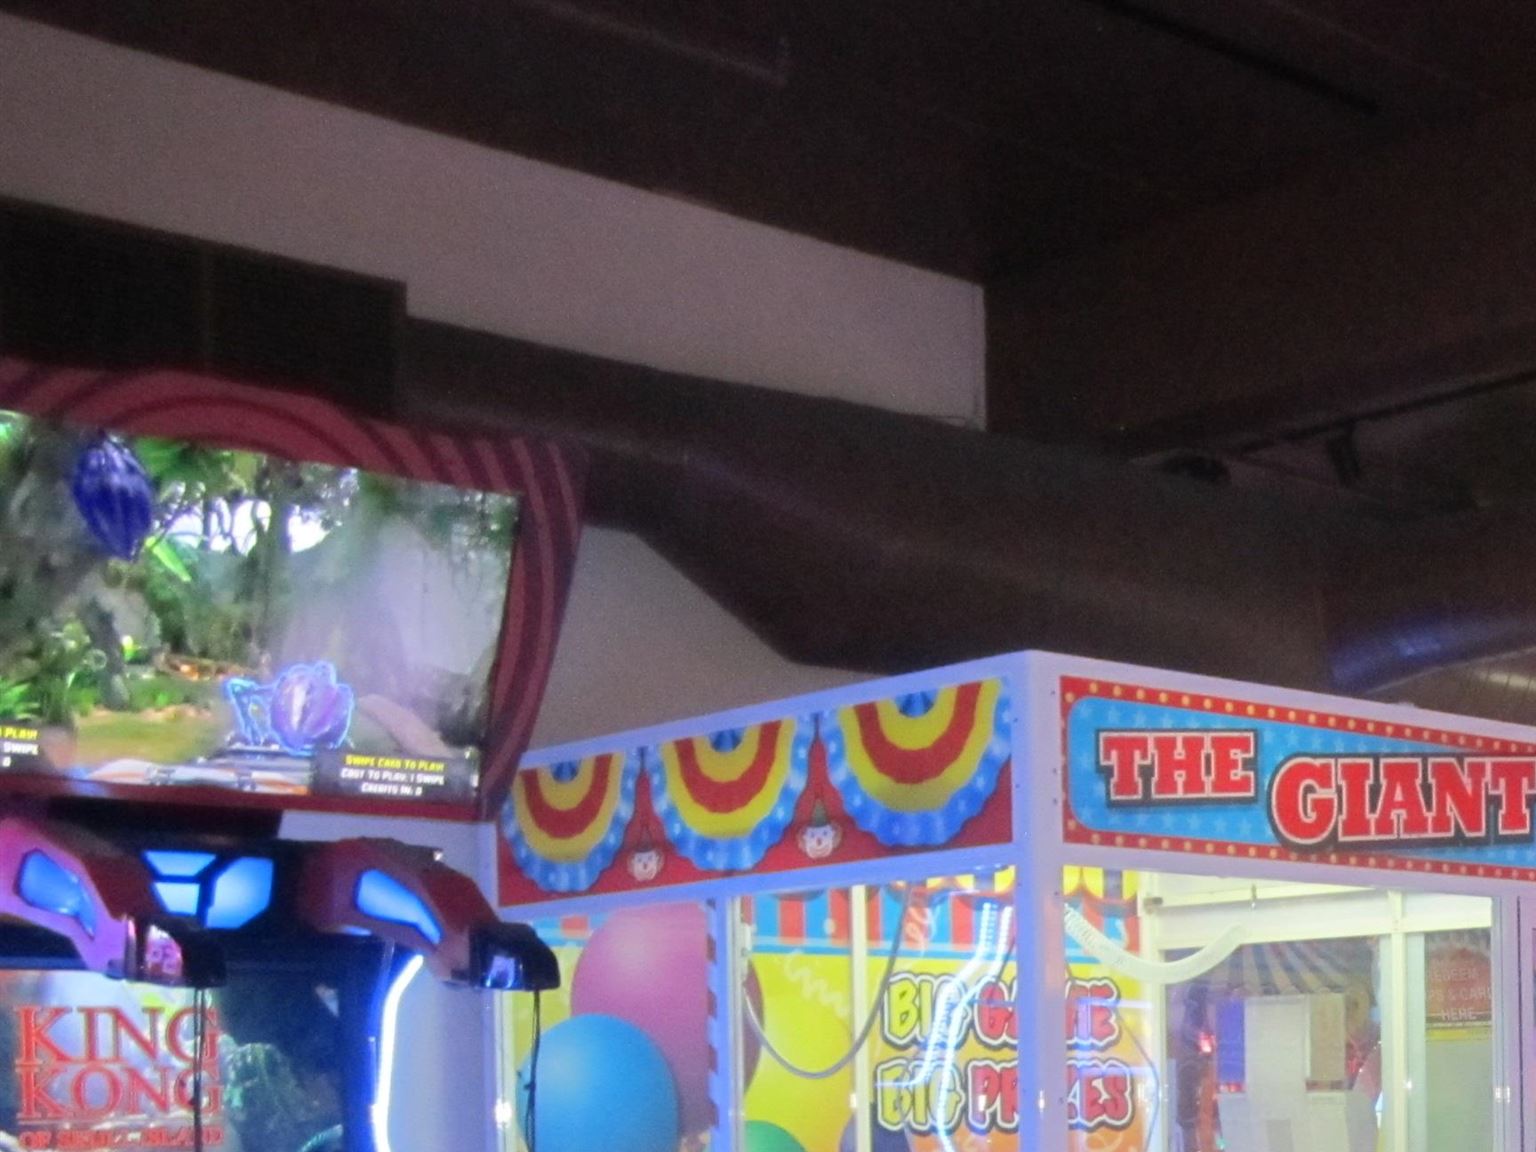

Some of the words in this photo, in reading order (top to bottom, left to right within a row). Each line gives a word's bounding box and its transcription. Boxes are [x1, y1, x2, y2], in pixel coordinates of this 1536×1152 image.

[1101, 731, 1255, 802] THE
[13, 1005, 221, 1066] KING
[15, 1061, 224, 1120] KONG
[967, 1060, 1135, 1132] PRES
